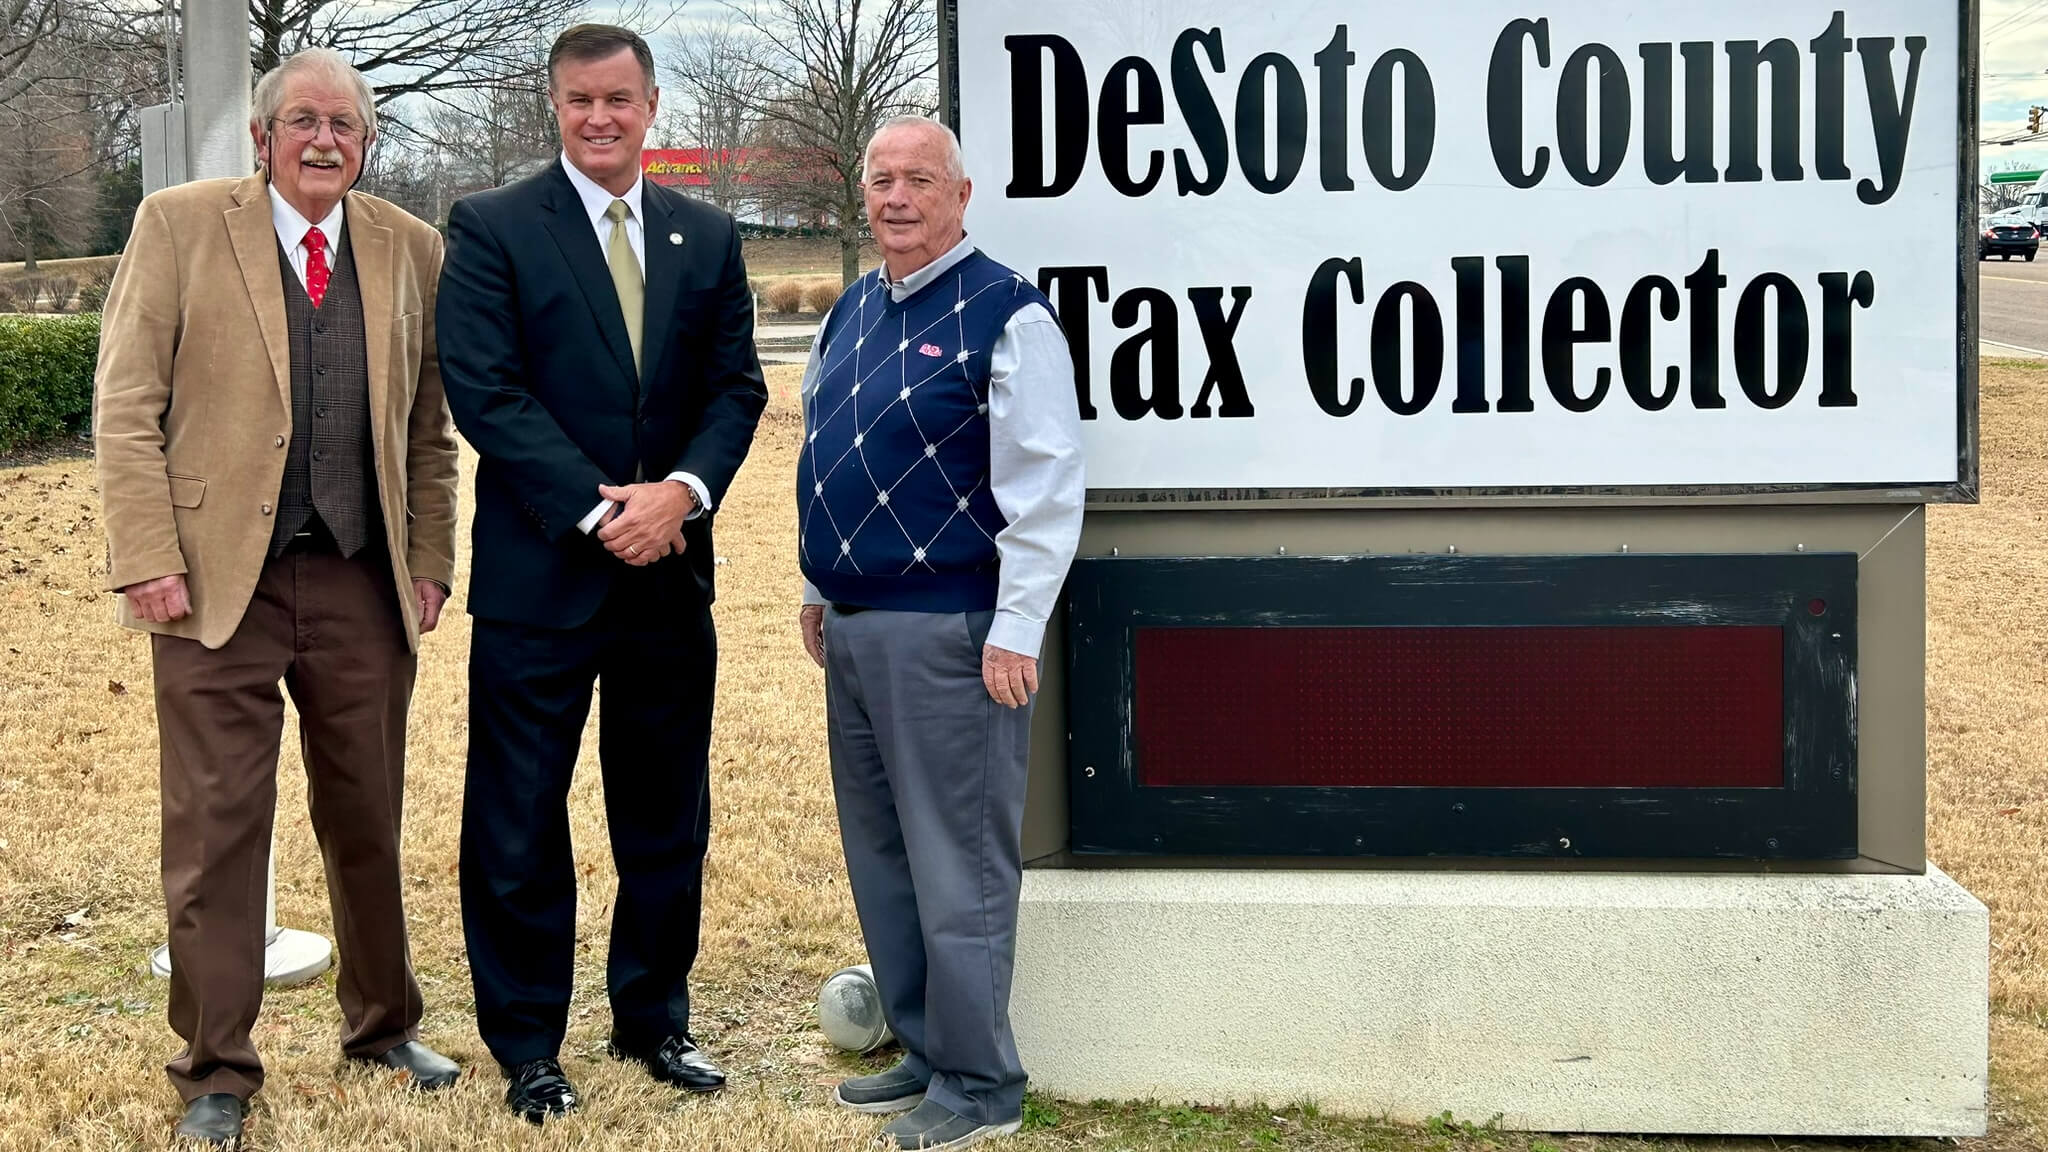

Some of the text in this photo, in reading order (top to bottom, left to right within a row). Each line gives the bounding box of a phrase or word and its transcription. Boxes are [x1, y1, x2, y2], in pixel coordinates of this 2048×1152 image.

[1004, 10, 1928, 206] DeSoto County
[1037, 248, 1875, 421] Tax Collector
